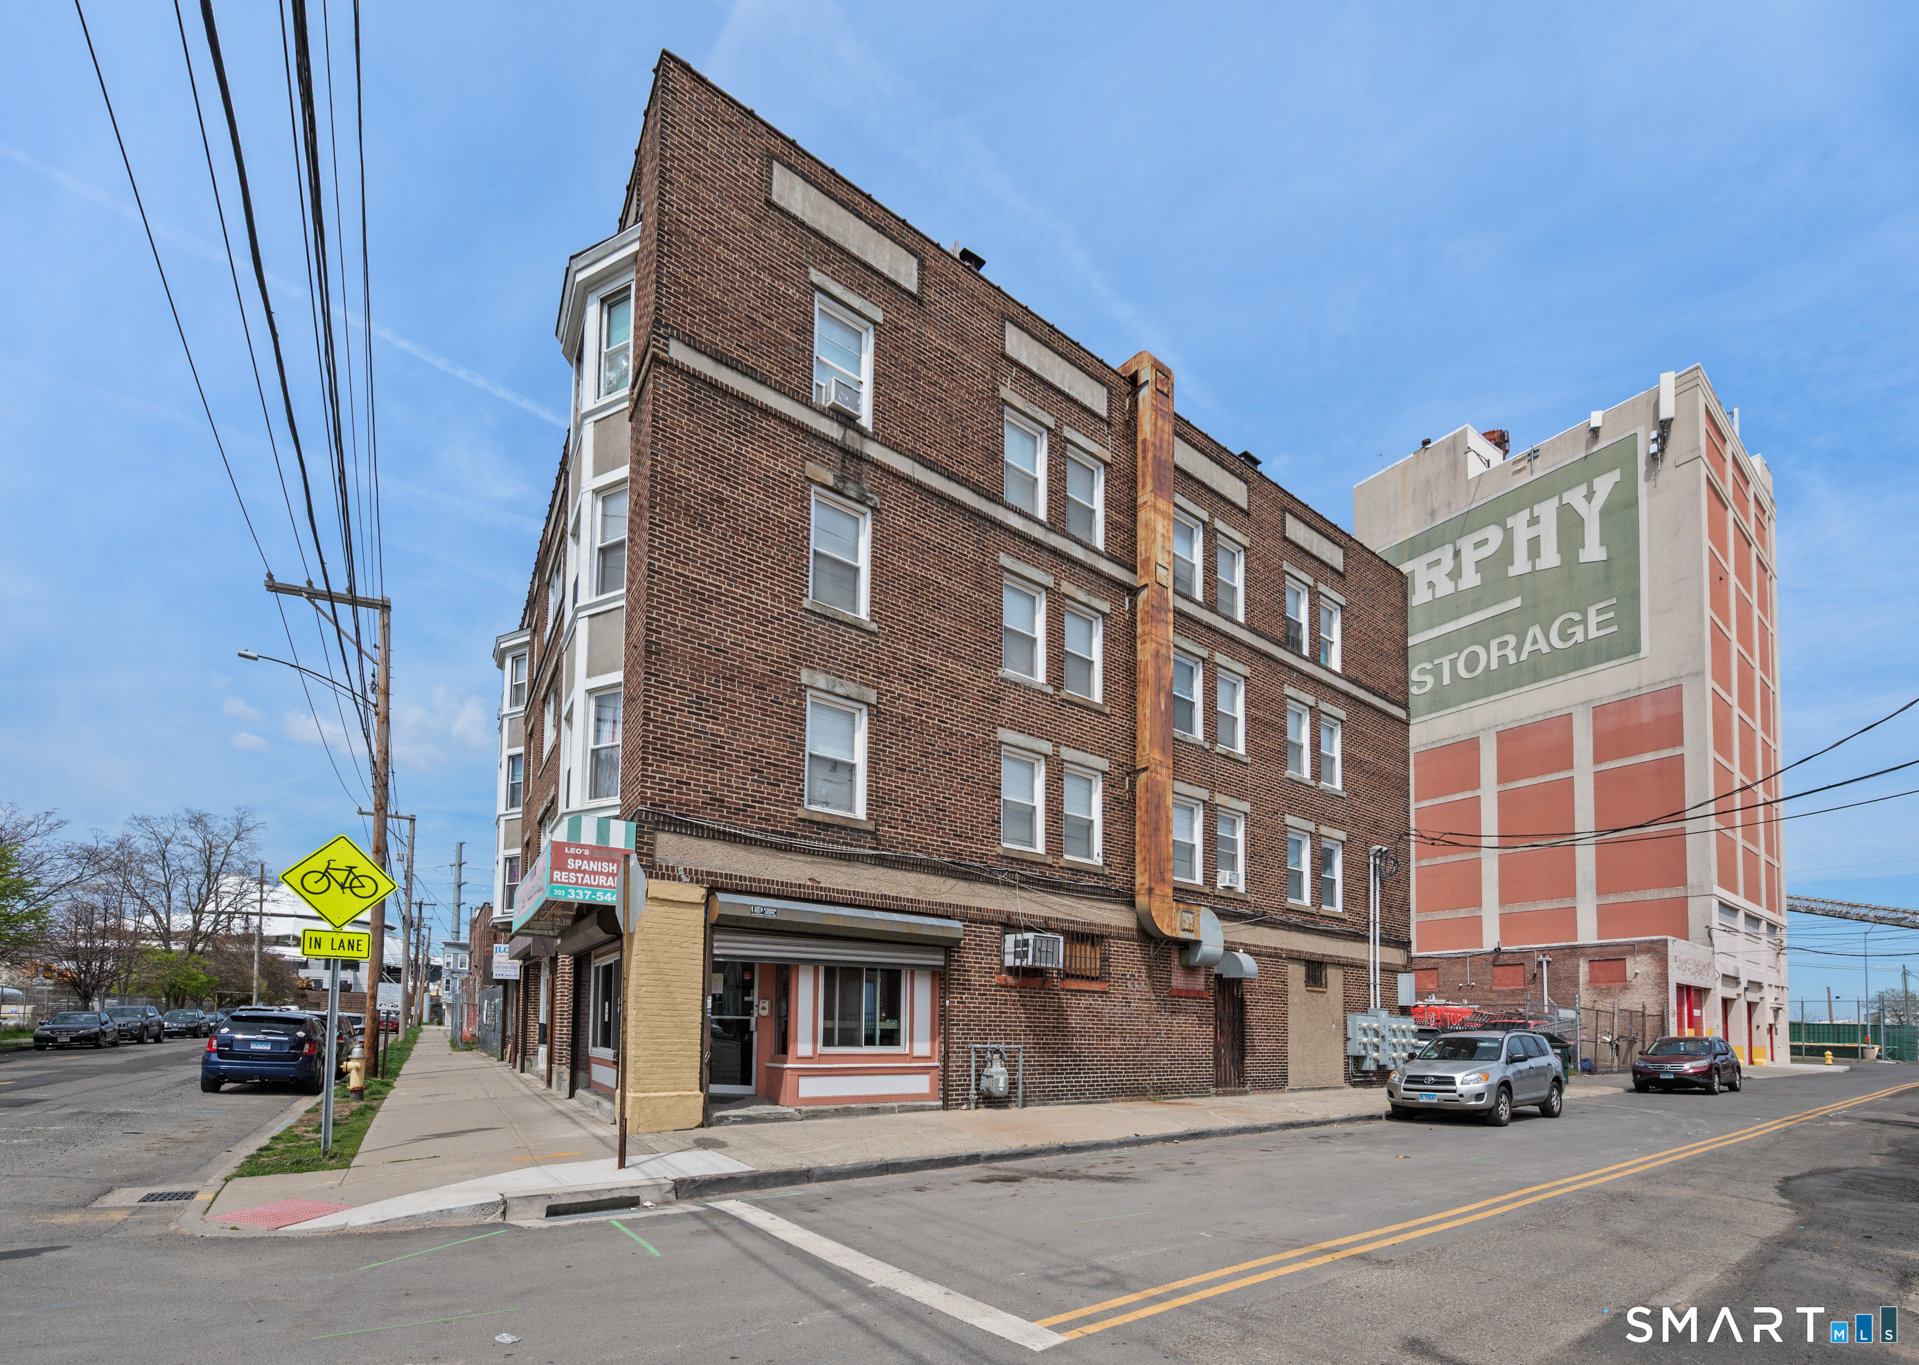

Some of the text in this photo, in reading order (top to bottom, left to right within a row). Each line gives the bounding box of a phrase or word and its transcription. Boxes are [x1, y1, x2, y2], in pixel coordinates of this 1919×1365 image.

[1397, 468, 1621, 608] RPHY
[1409, 597, 1618, 696] STORAGE
[565, 847, 590, 856] LEO'S
[567, 858, 618, 874] SPANISH
[553, 871, 618, 887] RESTAURA
[309, 936, 363, 952] IN LANE
